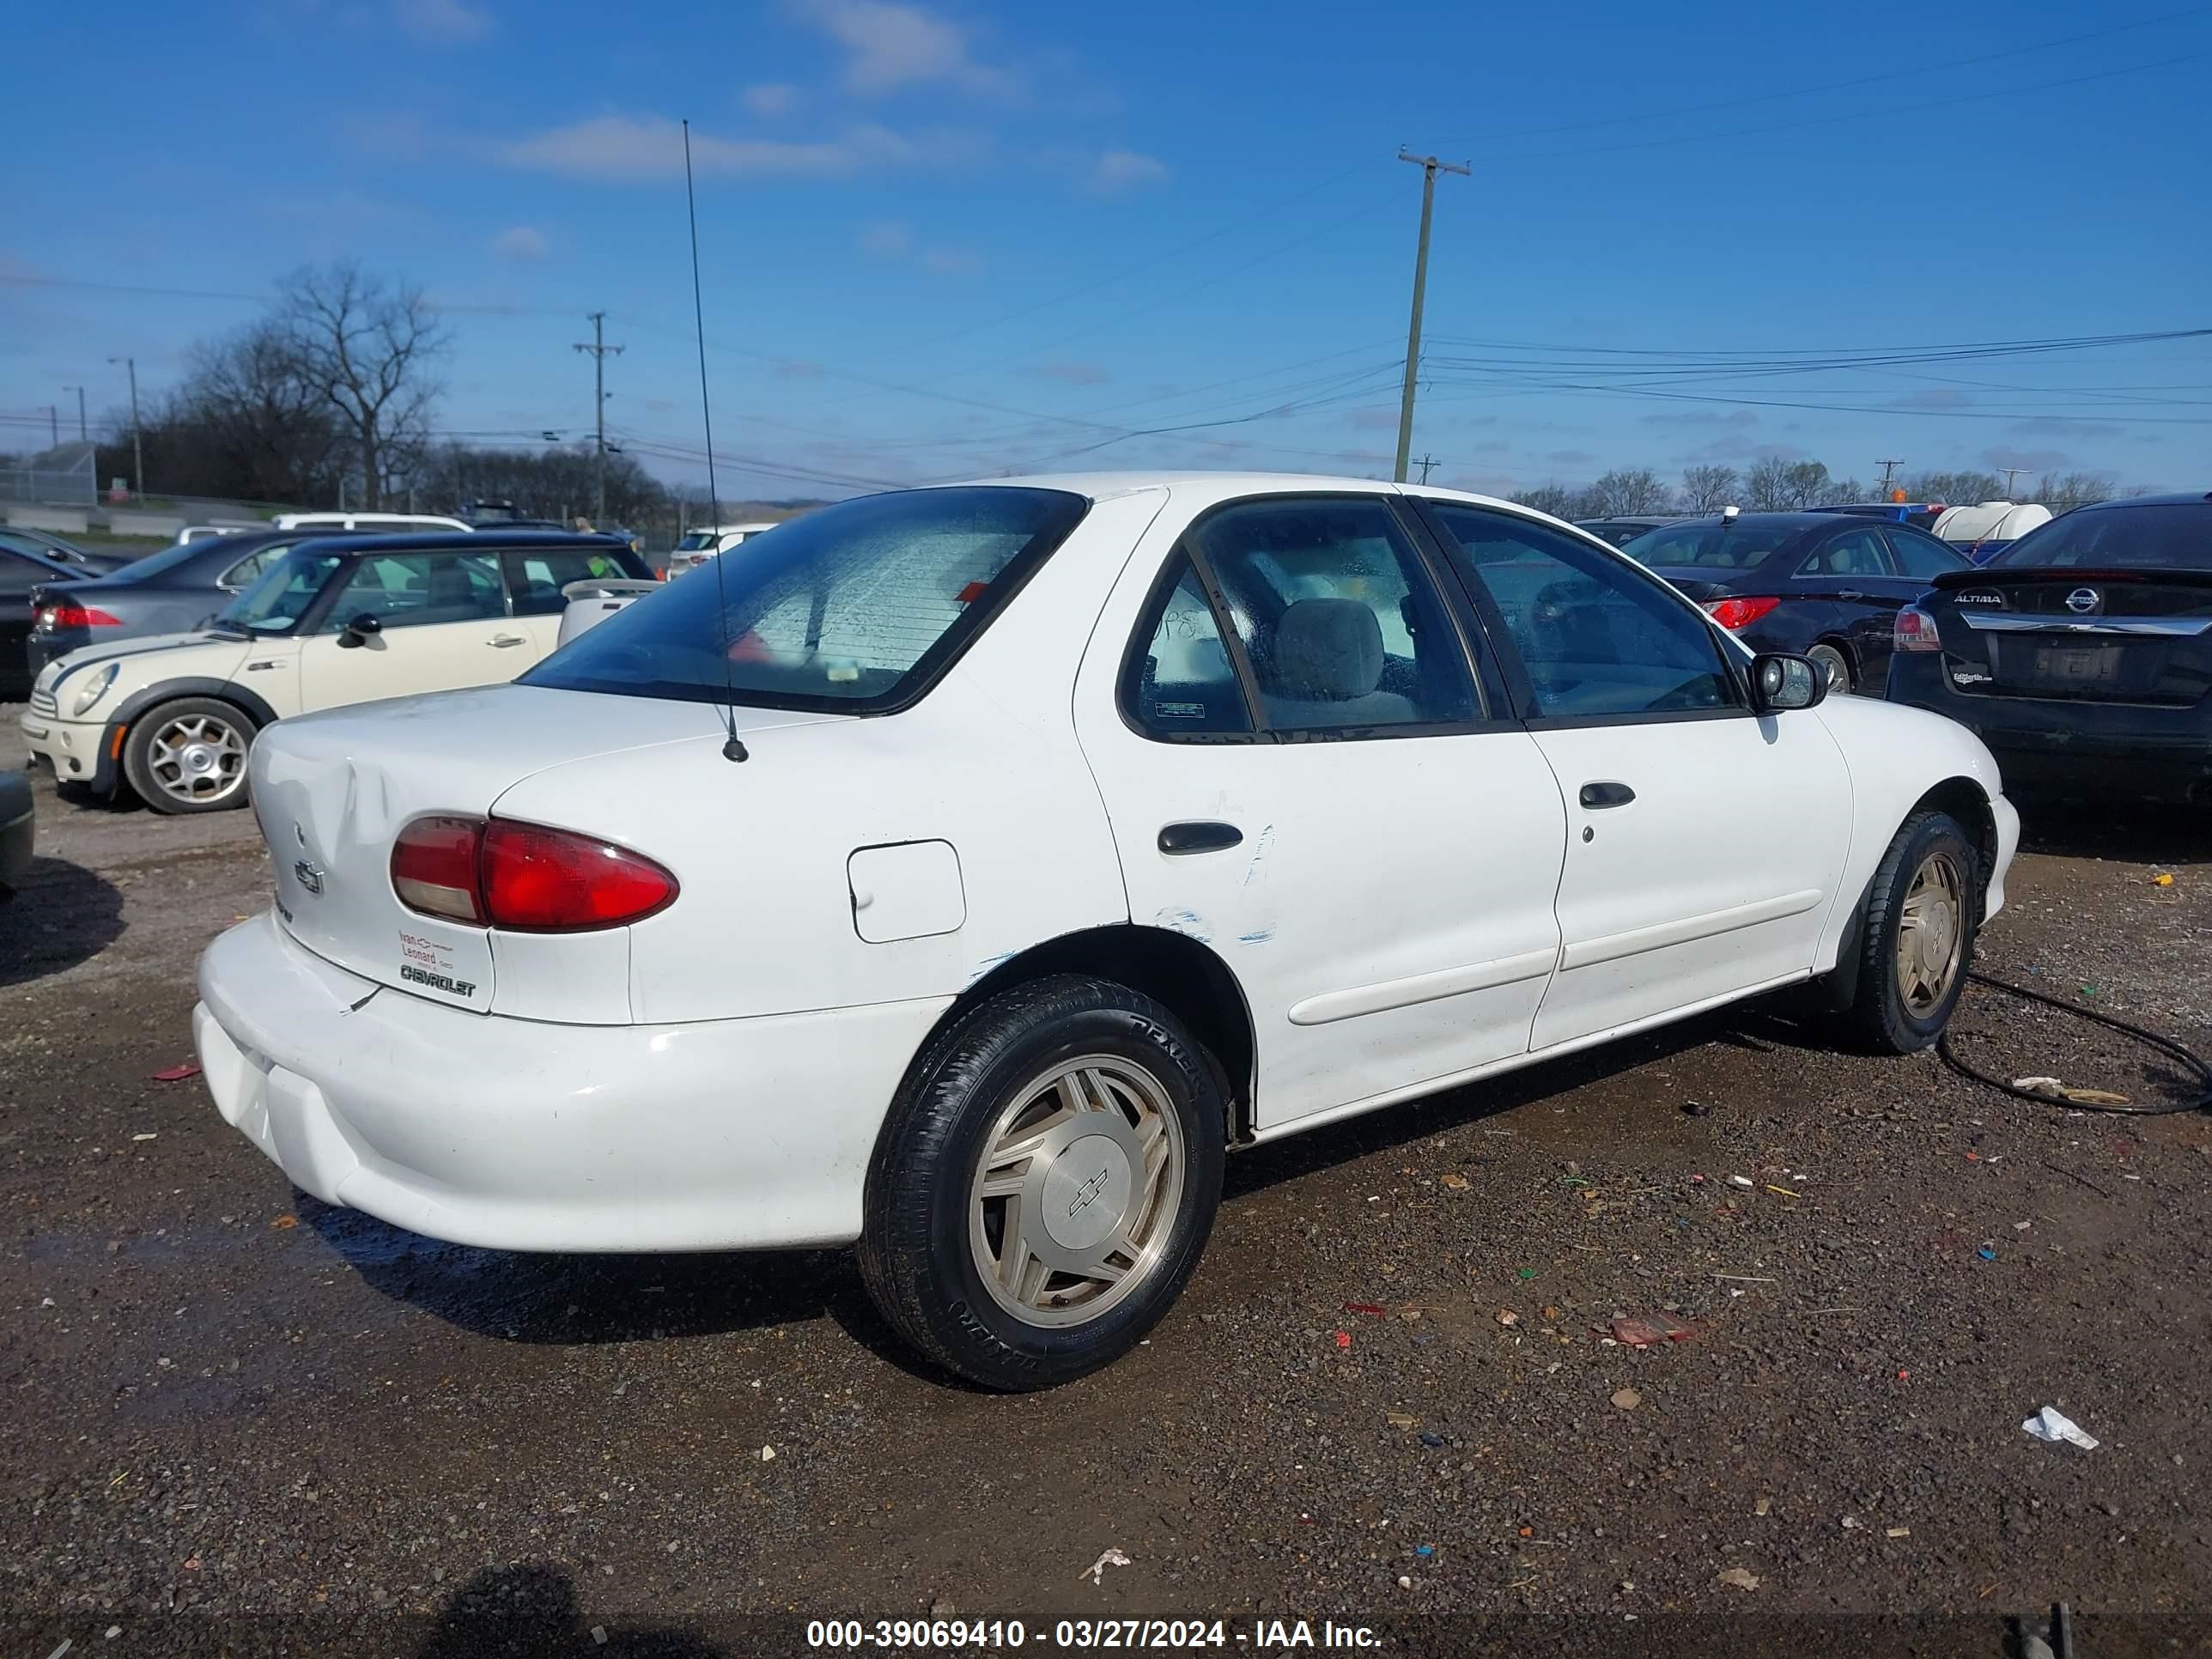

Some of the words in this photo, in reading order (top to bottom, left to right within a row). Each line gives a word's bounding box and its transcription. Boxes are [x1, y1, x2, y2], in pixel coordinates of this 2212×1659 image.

[1954, 594, 2002, 605] ALTIMA
[401, 944, 437, 964] Leonard
[399, 963, 477, 998] CHEVROLET
